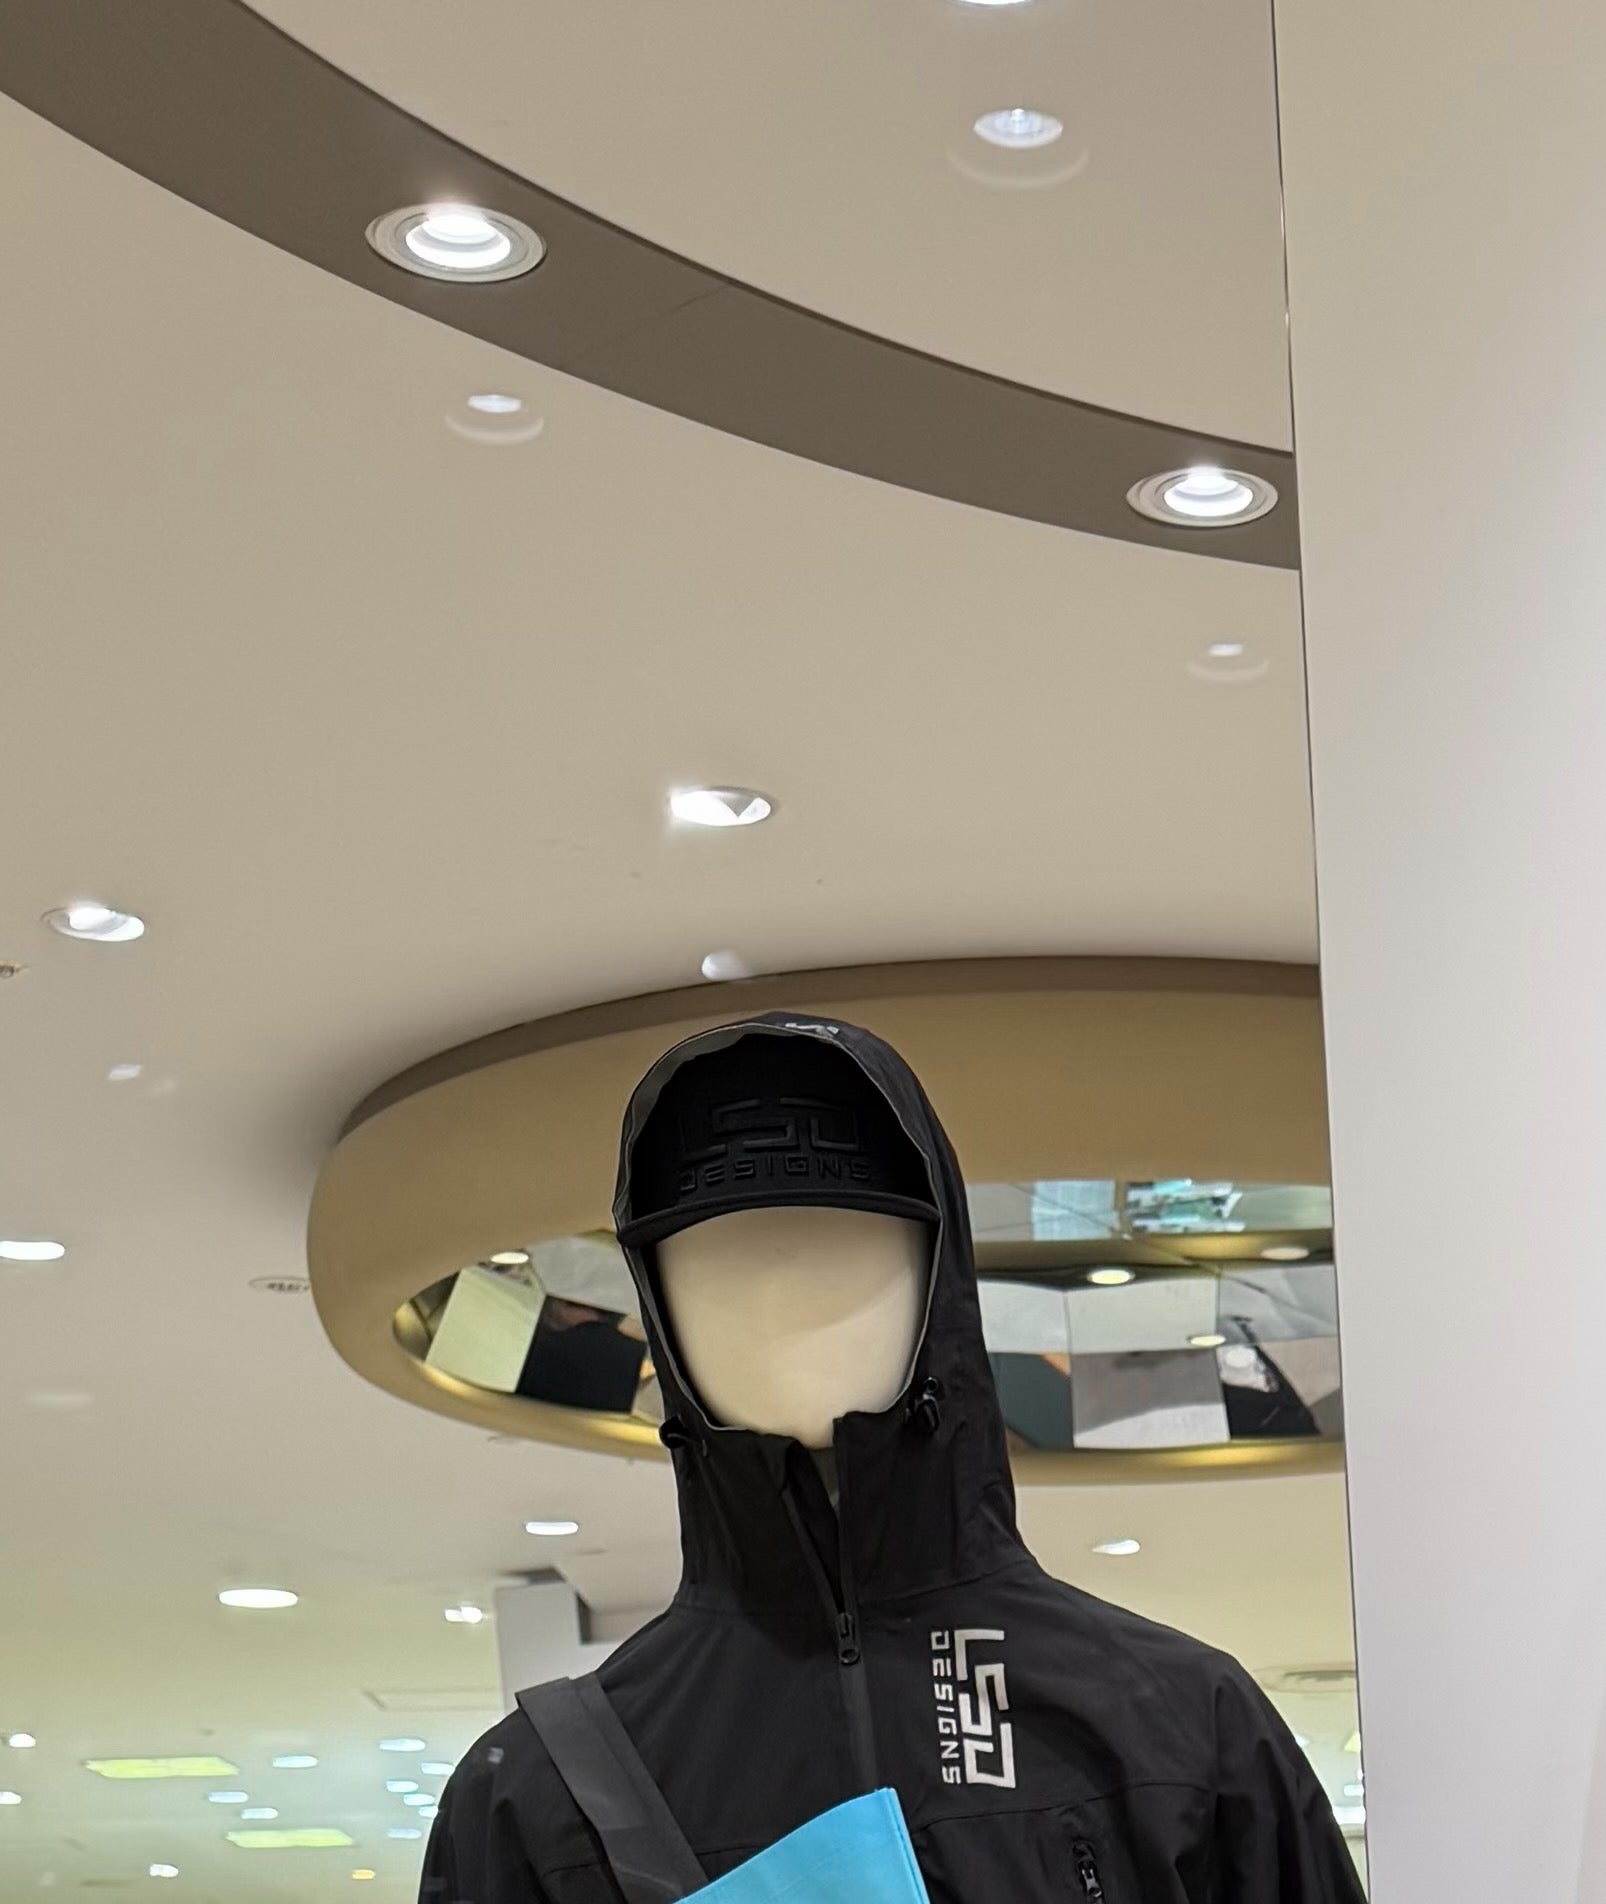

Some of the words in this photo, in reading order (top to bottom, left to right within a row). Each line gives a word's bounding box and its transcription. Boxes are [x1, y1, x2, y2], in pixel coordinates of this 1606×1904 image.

[678, 1153, 872, 1194] DESIGNS
[931, 1630, 962, 1785] DESIGNS
[954, 1628, 1016, 1789] LSD
